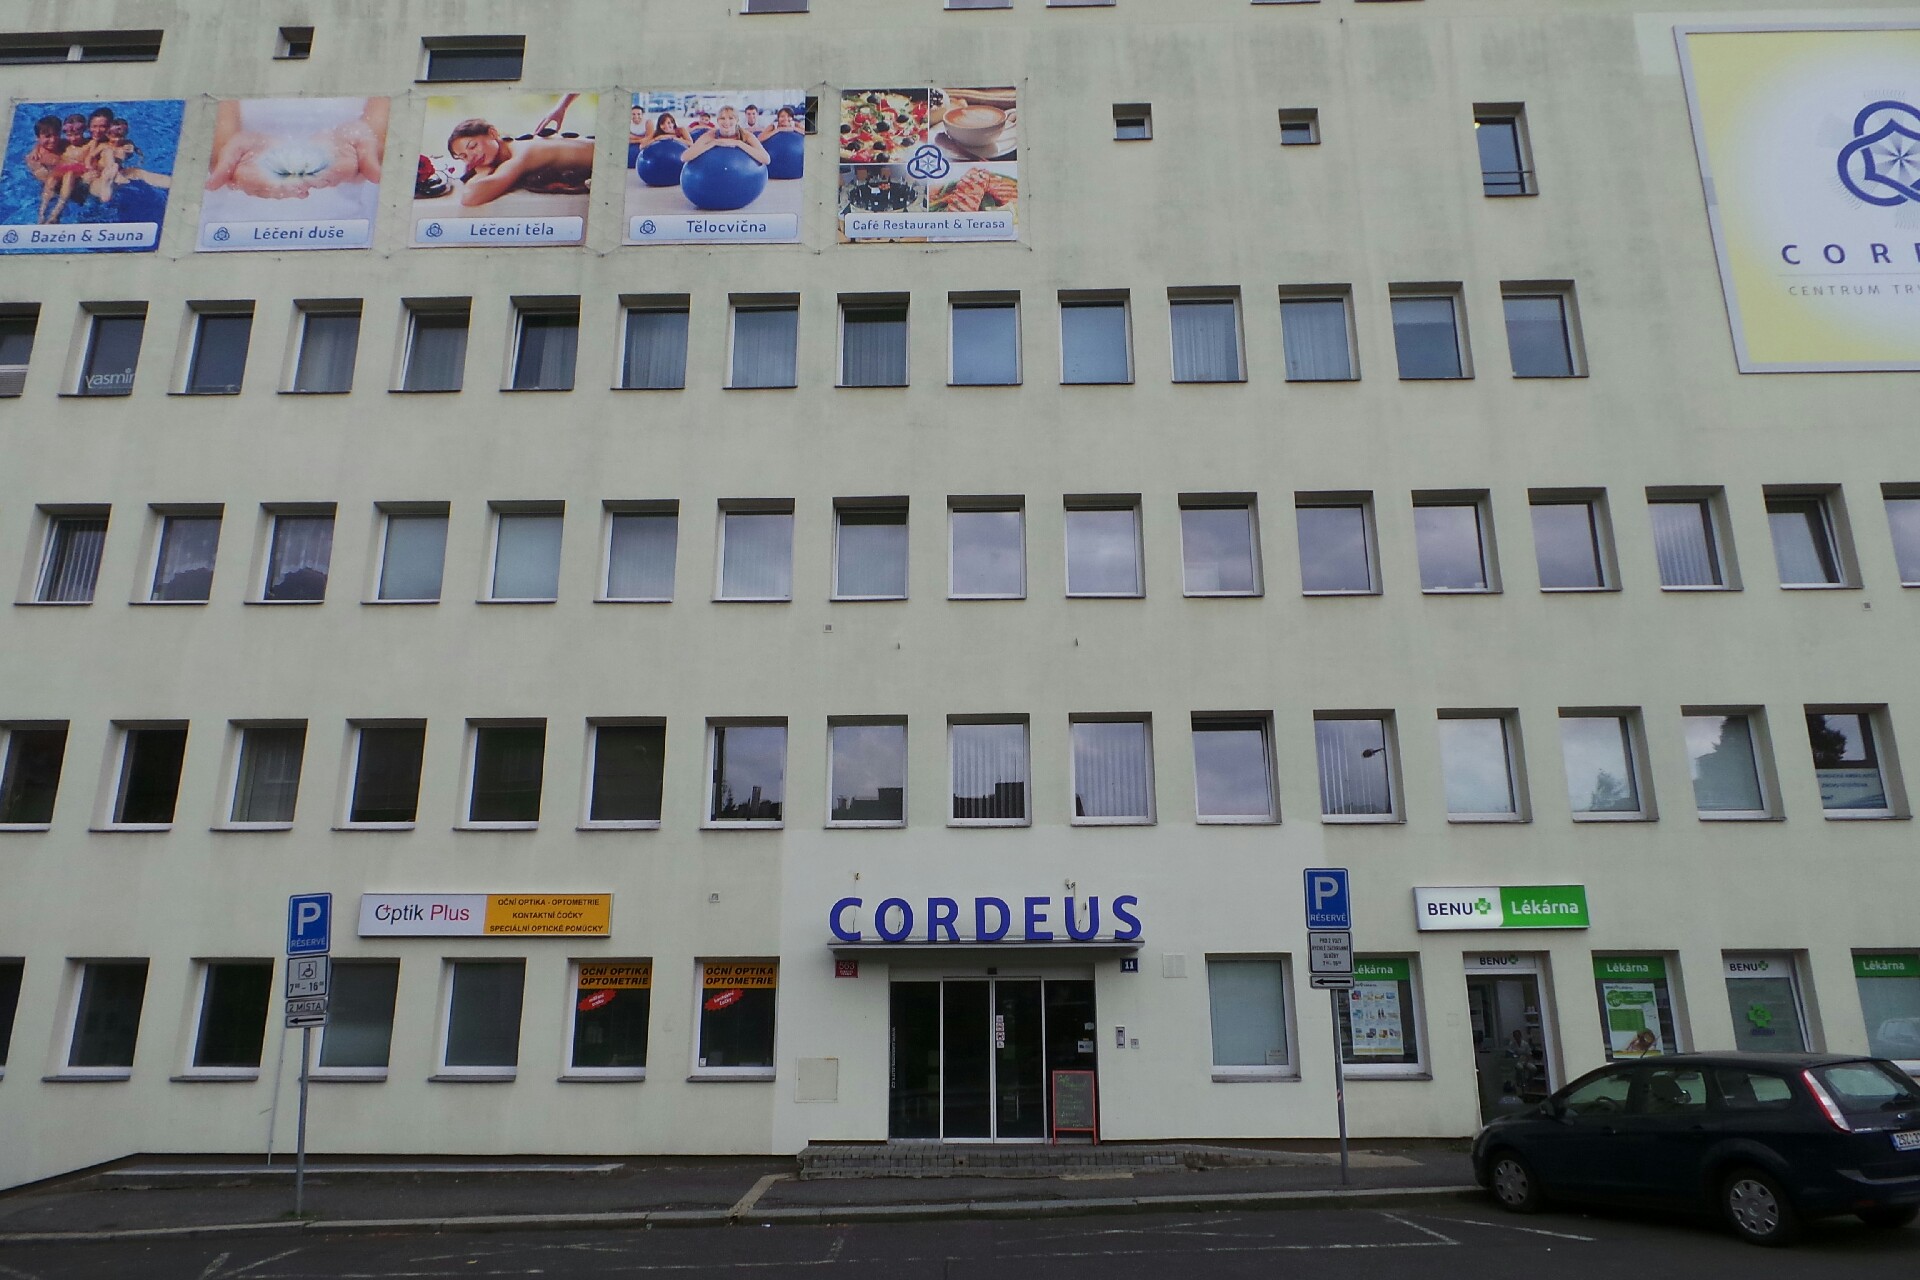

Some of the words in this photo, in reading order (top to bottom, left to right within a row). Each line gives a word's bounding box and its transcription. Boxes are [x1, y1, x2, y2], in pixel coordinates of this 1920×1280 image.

[470, 223, 521, 236] Léčení
[525, 222, 554, 236] těla
[686, 219, 767, 233] Tělocvična
[852, 220, 879, 231] Café
[883, 219, 949, 230] Restaurant
[953, 219, 962, 229] &
[966, 218, 1005, 229] Terasa
[31, 230, 76, 243] Bazén
[81, 229, 92, 242] &
[97, 229, 144, 242] Sauna
[253, 227, 304, 240] Léčení
[308, 225, 345, 239] duše
[1788, 285, 1881, 296] CENTRUM
[1314, 876, 1339, 910] P
[518, 898, 546, 906] OPTIKA
[552, 898, 600, 906] OPTOMETRIE
[1427, 903, 1473, 916] BENU
[1511, 899, 1579, 915] Lékárna
[297, 902, 322, 935] P
[374, 904, 424, 925] Optik
[430, 904, 470, 921] Plus
[512, 910, 555, 919] KONTAKTNÍ
[828, 895, 1142, 942] CORDEUS
[1124, 960, 1134, 970] 11
[1479, 956, 1508, 966] BENU
[1863, 960, 1905, 970] Lékárna
[610, 967, 649, 976] OPTIKA
[735, 967, 774, 975] OPTIKA
[1606, 962, 1649, 973] Lékárna
[1729, 963, 1758, 972] BENU
[580, 977, 648, 986] OPTOMETRIE
[705, 977, 773, 985] OPTOMETRIE
